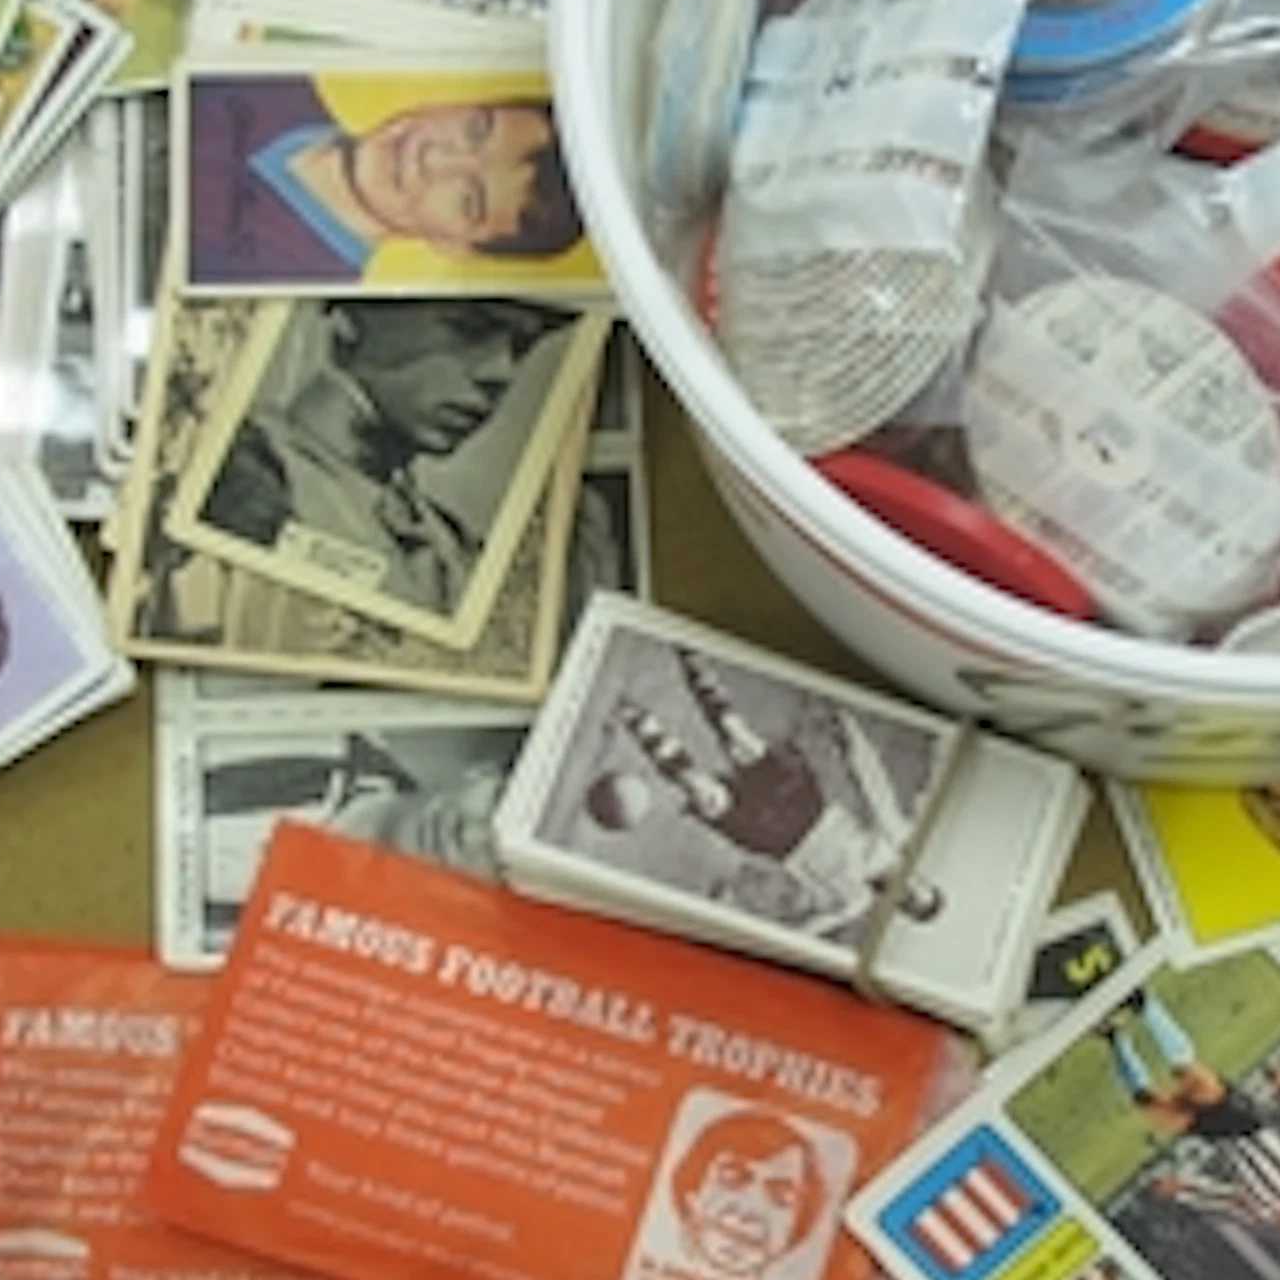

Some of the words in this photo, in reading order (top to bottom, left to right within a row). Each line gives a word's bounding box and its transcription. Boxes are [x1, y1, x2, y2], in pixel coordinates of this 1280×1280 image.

[1, 1008, 181, 1058] FAMOUS
[263, 893, 436, 975] FAMOUS
[438, 946, 658, 1043] FOOTBALL
[667, 1014, 885, 1116] TROPHIES
